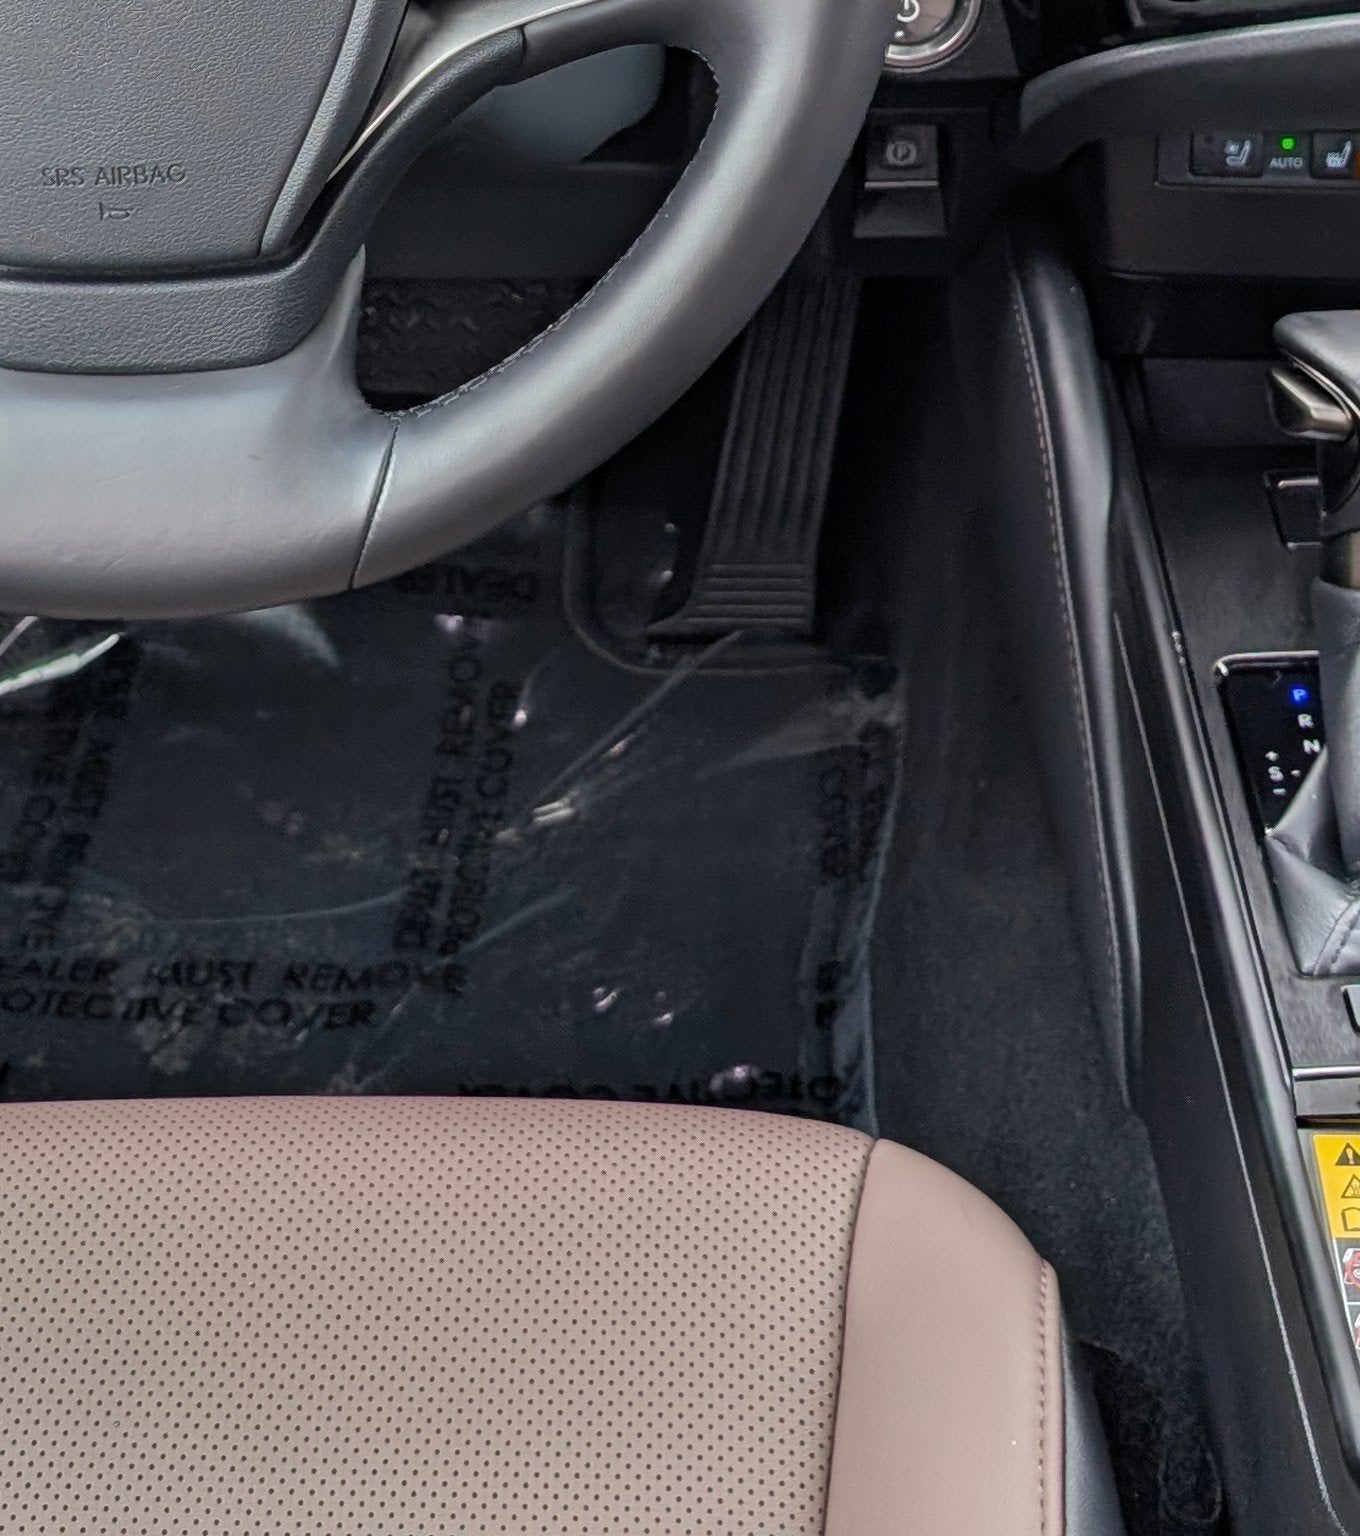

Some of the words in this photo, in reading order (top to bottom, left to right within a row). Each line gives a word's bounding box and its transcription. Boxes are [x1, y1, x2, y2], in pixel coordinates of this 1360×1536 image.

[1270, 156, 1304, 169] AUTO
[41, 166, 86, 187] SRS
[94, 164, 187, 186] AIRBAG
[1292, 688, 1308, 702] P
[1297, 713, 1314, 729] R
[1303, 738, 1321, 754] N
